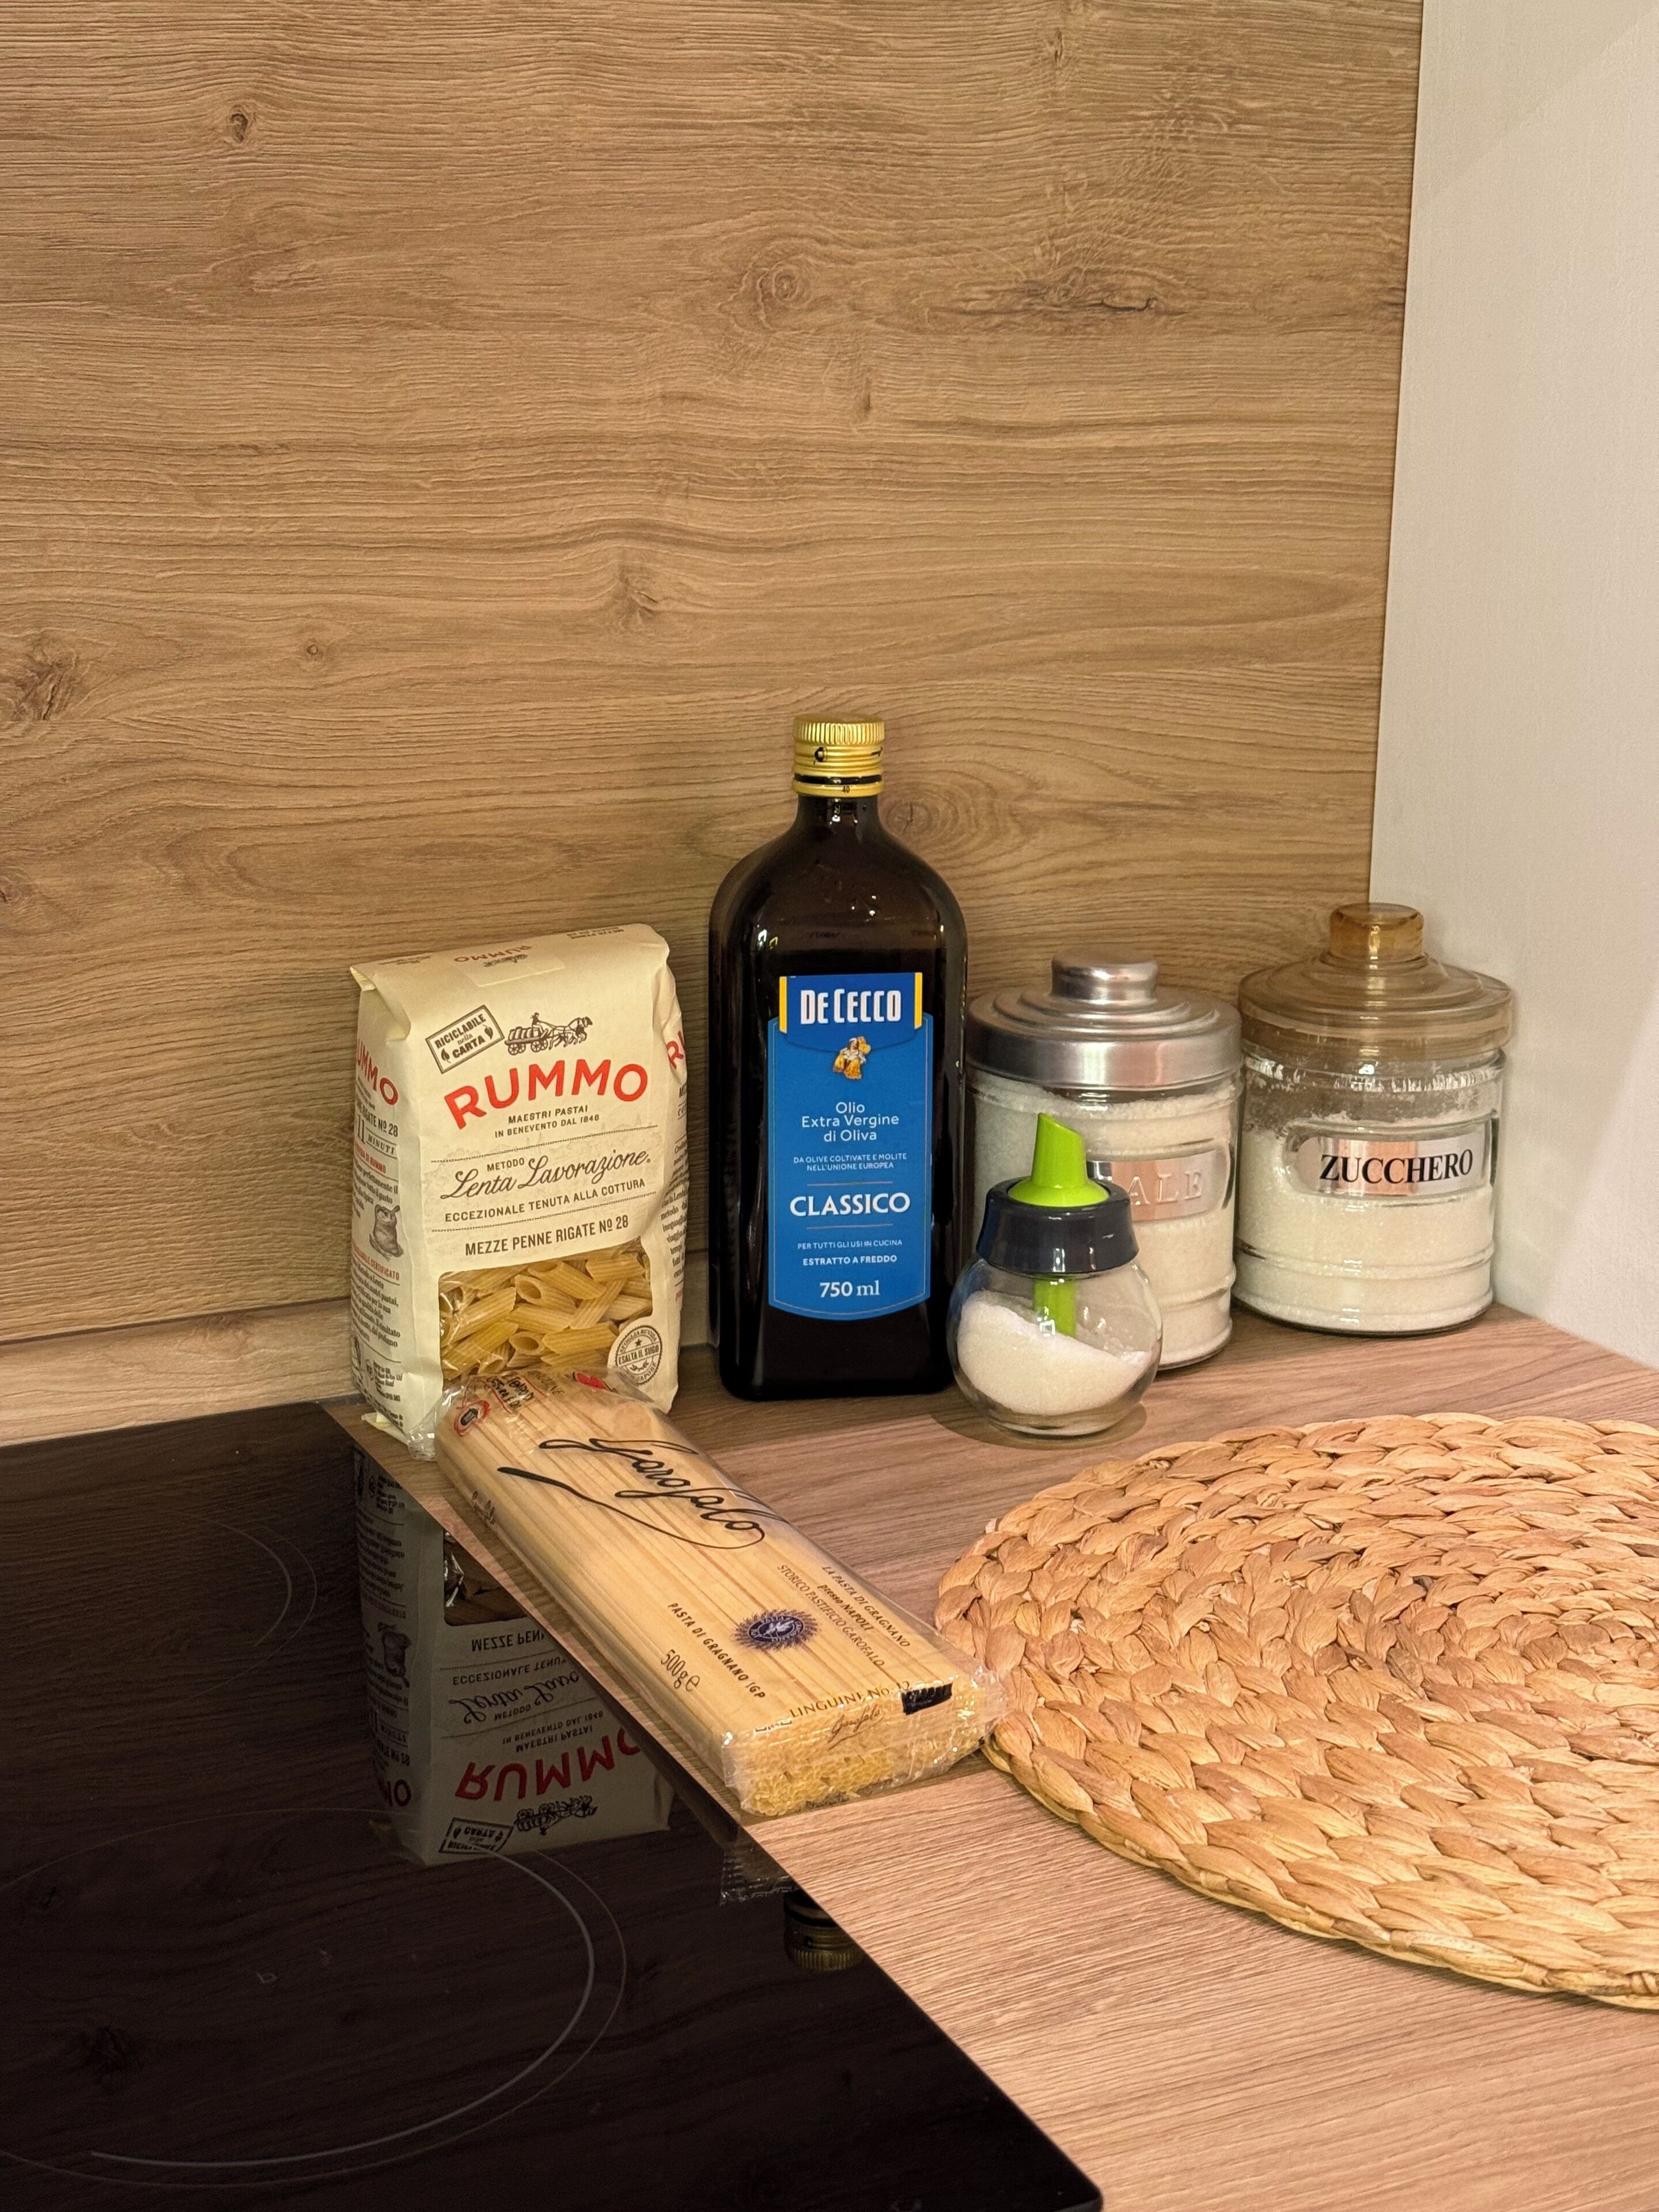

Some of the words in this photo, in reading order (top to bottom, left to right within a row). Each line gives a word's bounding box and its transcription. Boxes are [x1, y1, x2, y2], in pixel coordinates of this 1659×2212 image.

[454, 945, 532, 963] RUMMO
[834, 988, 902, 1024] CECCO
[434, 1014, 486, 1049] RICICLABILE
[457, 1033, 473, 1046] nella
[452, 1035, 486, 1058] CARTA
[444, 1059, 648, 1129] RUMMO
[508, 1109, 552, 1124] MAESTRI
[555, 1105, 588, 1116] PASTAI
[836, 1102, 865, 1113] Olio
[388, 1123, 399, 1138] 28
[495, 1130, 505, 1138] IN
[507, 1121, 558, 1137] BENEVENTO
[560, 1118, 577, 1127] DAL
[579, 1113, 599, 1123] 1846
[802, 1115, 840, 1128] Extra
[843, 1114, 899, 1128] Vergine
[368, 1134, 395, 1155] MINUTI
[824, 1131, 836, 1142] di
[840, 1129, 877, 1141] Oliva
[487, 1158, 525, 1172] METODO
[830, 1154, 871, 1162] COLTIVATE
[878, 1153, 907, 1161] MOLITE
[858, 1162, 893, 1170] EUROPEA
[1320, 1149, 1473, 1183] ZUCCHERO
[440, 1168, 518, 1199] Lenta
[1129, 1166, 1205, 1206] ALE
[445, 1203, 525, 1222] ECCEZIONALE
[528, 1195, 569, 1211] TENUTA
[573, 1189, 598, 1202] ALLA
[601, 1178, 646, 1196] COTTURA
[790, 1192, 911, 1217] CLASSICO
[465, 1238, 509, 1256] MEZZE
[512, 1231, 552, 1249] PENNE
[556, 1222, 596, 1242] RIGATE
[615, 1214, 628, 1230] 28
[873, 1239, 903, 1247] CUCINA
[802, 1256, 850, 1266] ESTRATTO
[860, 1255, 897, 1263] FREDDO
[819, 1281, 853, 1298] 750
[856, 1280, 880, 1296] ml
[618, 1353, 638, 1365] ESALTA
[645, 1344, 659, 1357] SUGO
[497, 1438, 789, 1550] Garofalo
[778, 1564, 810, 1592] STORICO
[805, 1589, 846, 1627] PASTIFICIO
[843, 1626, 885, 1667] GAROFALO
[817, 1584, 843, 1604] presso
[841, 1603, 874, 1631] NAPOLI
[822, 1566, 834, 1576] LA
[833, 1575, 856, 1596] PASTA
[854, 1596, 868, 1605] DI
[864, 1605, 911, 1647] GRAGNANO
[668, 1603, 695, 1628] PASTA
[692, 1627, 707, 1638] DI
[703, 1638, 749, 1681] GRAGNANO
[745, 1681, 766, 1698] IGP
